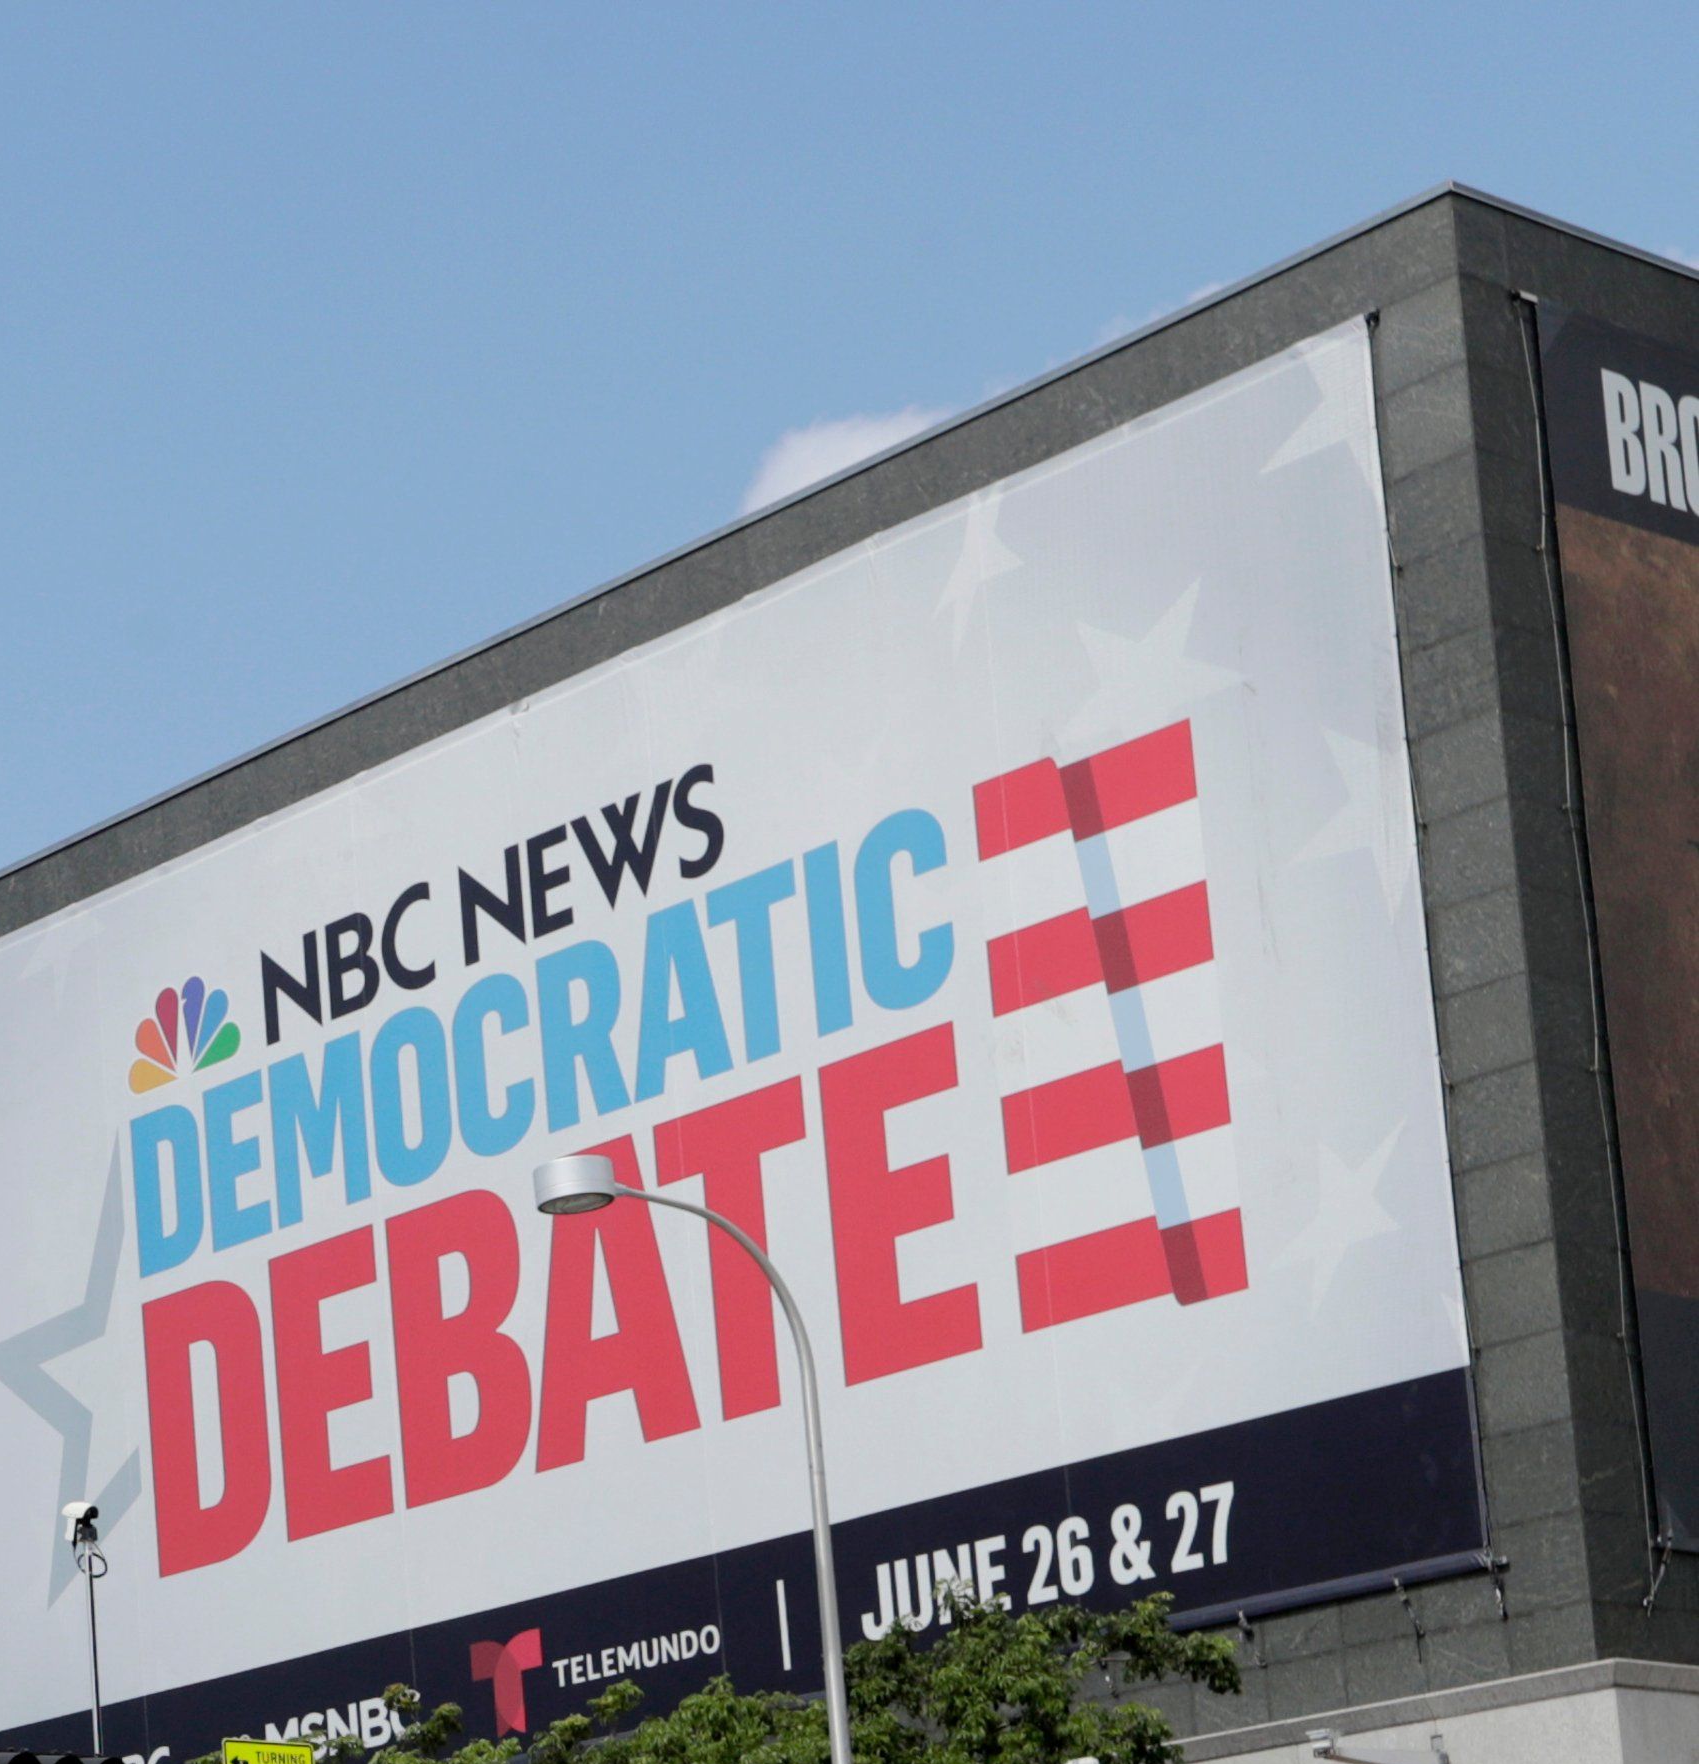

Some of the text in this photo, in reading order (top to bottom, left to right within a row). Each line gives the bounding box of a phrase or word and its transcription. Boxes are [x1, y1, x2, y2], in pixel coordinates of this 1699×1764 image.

[129, 807, 955, 1280] DEMOCRATIC
[259, 762, 726, 1046] NBC NEWS
[140, 1020, 984, 1579] DEBATE
[552, 1624, 721, 1688] TELEMUNDO
[861, 1481, 1235, 1641] JUNE 26 & 27
